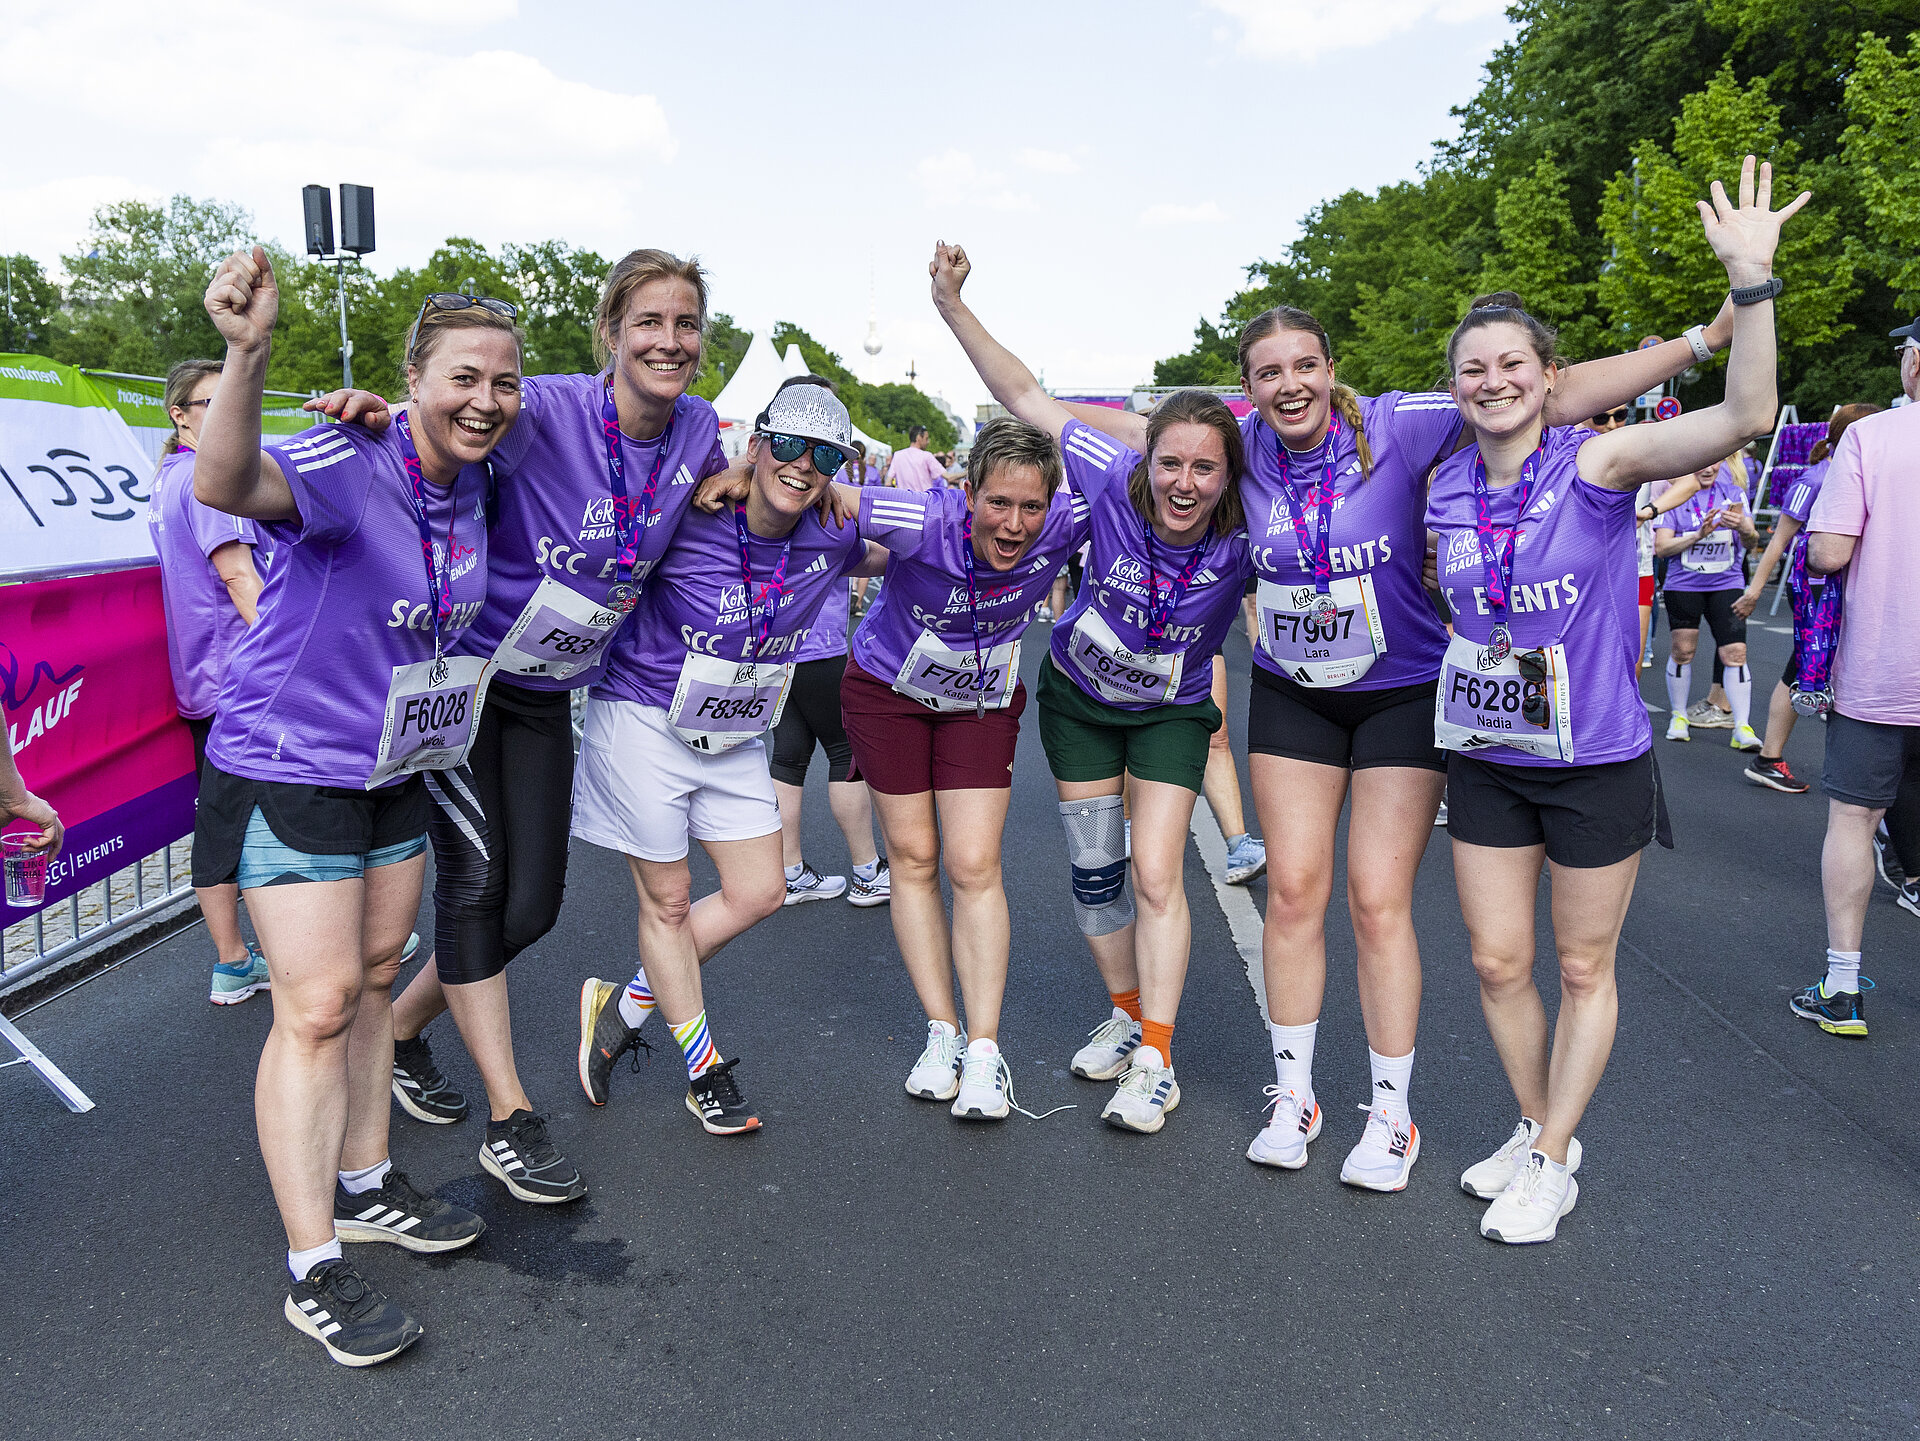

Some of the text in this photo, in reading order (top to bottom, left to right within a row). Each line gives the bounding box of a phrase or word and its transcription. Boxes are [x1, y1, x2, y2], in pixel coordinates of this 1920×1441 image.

[578, 513, 662, 541] FRAUUF
[582, 497, 615, 528] KoR
[535, 536, 588, 575] SCC
[1297, 535, 1392, 573] EENTS
[1447, 529, 1479, 562] KoRo
[1690, 543, 1726, 556] F7977
[1109, 554, 1144, 584] KoRo
[720, 584, 753, 613] KoR
[1291, 588, 1317, 610] KoRo
[1473, 573, 1579, 615] EENTS
[715, 594, 795, 626] FRAUENUF
[911, 605, 952, 631] SCC
[1122, 605, 1205, 643] EVNTS
[538, 627, 600, 655] F83
[680, 624, 724, 655] SCC
[1273, 609, 1355, 644] F7907
[1083, 643, 1160, 689] F6780
[1113, 646, 1137, 664] KoRo
[1304, 647, 1330, 659] Lara
[943, 688, 970, 700] Katja
[1093, 667, 1139, 696] Katharina
[400, 691, 467, 737] F6028
[695, 696, 768, 719] F8345
[1477, 714, 1512, 730] Nadia
[1560, 715, 1569, 729] SCC
[76, 835, 124, 869] EVENTS
